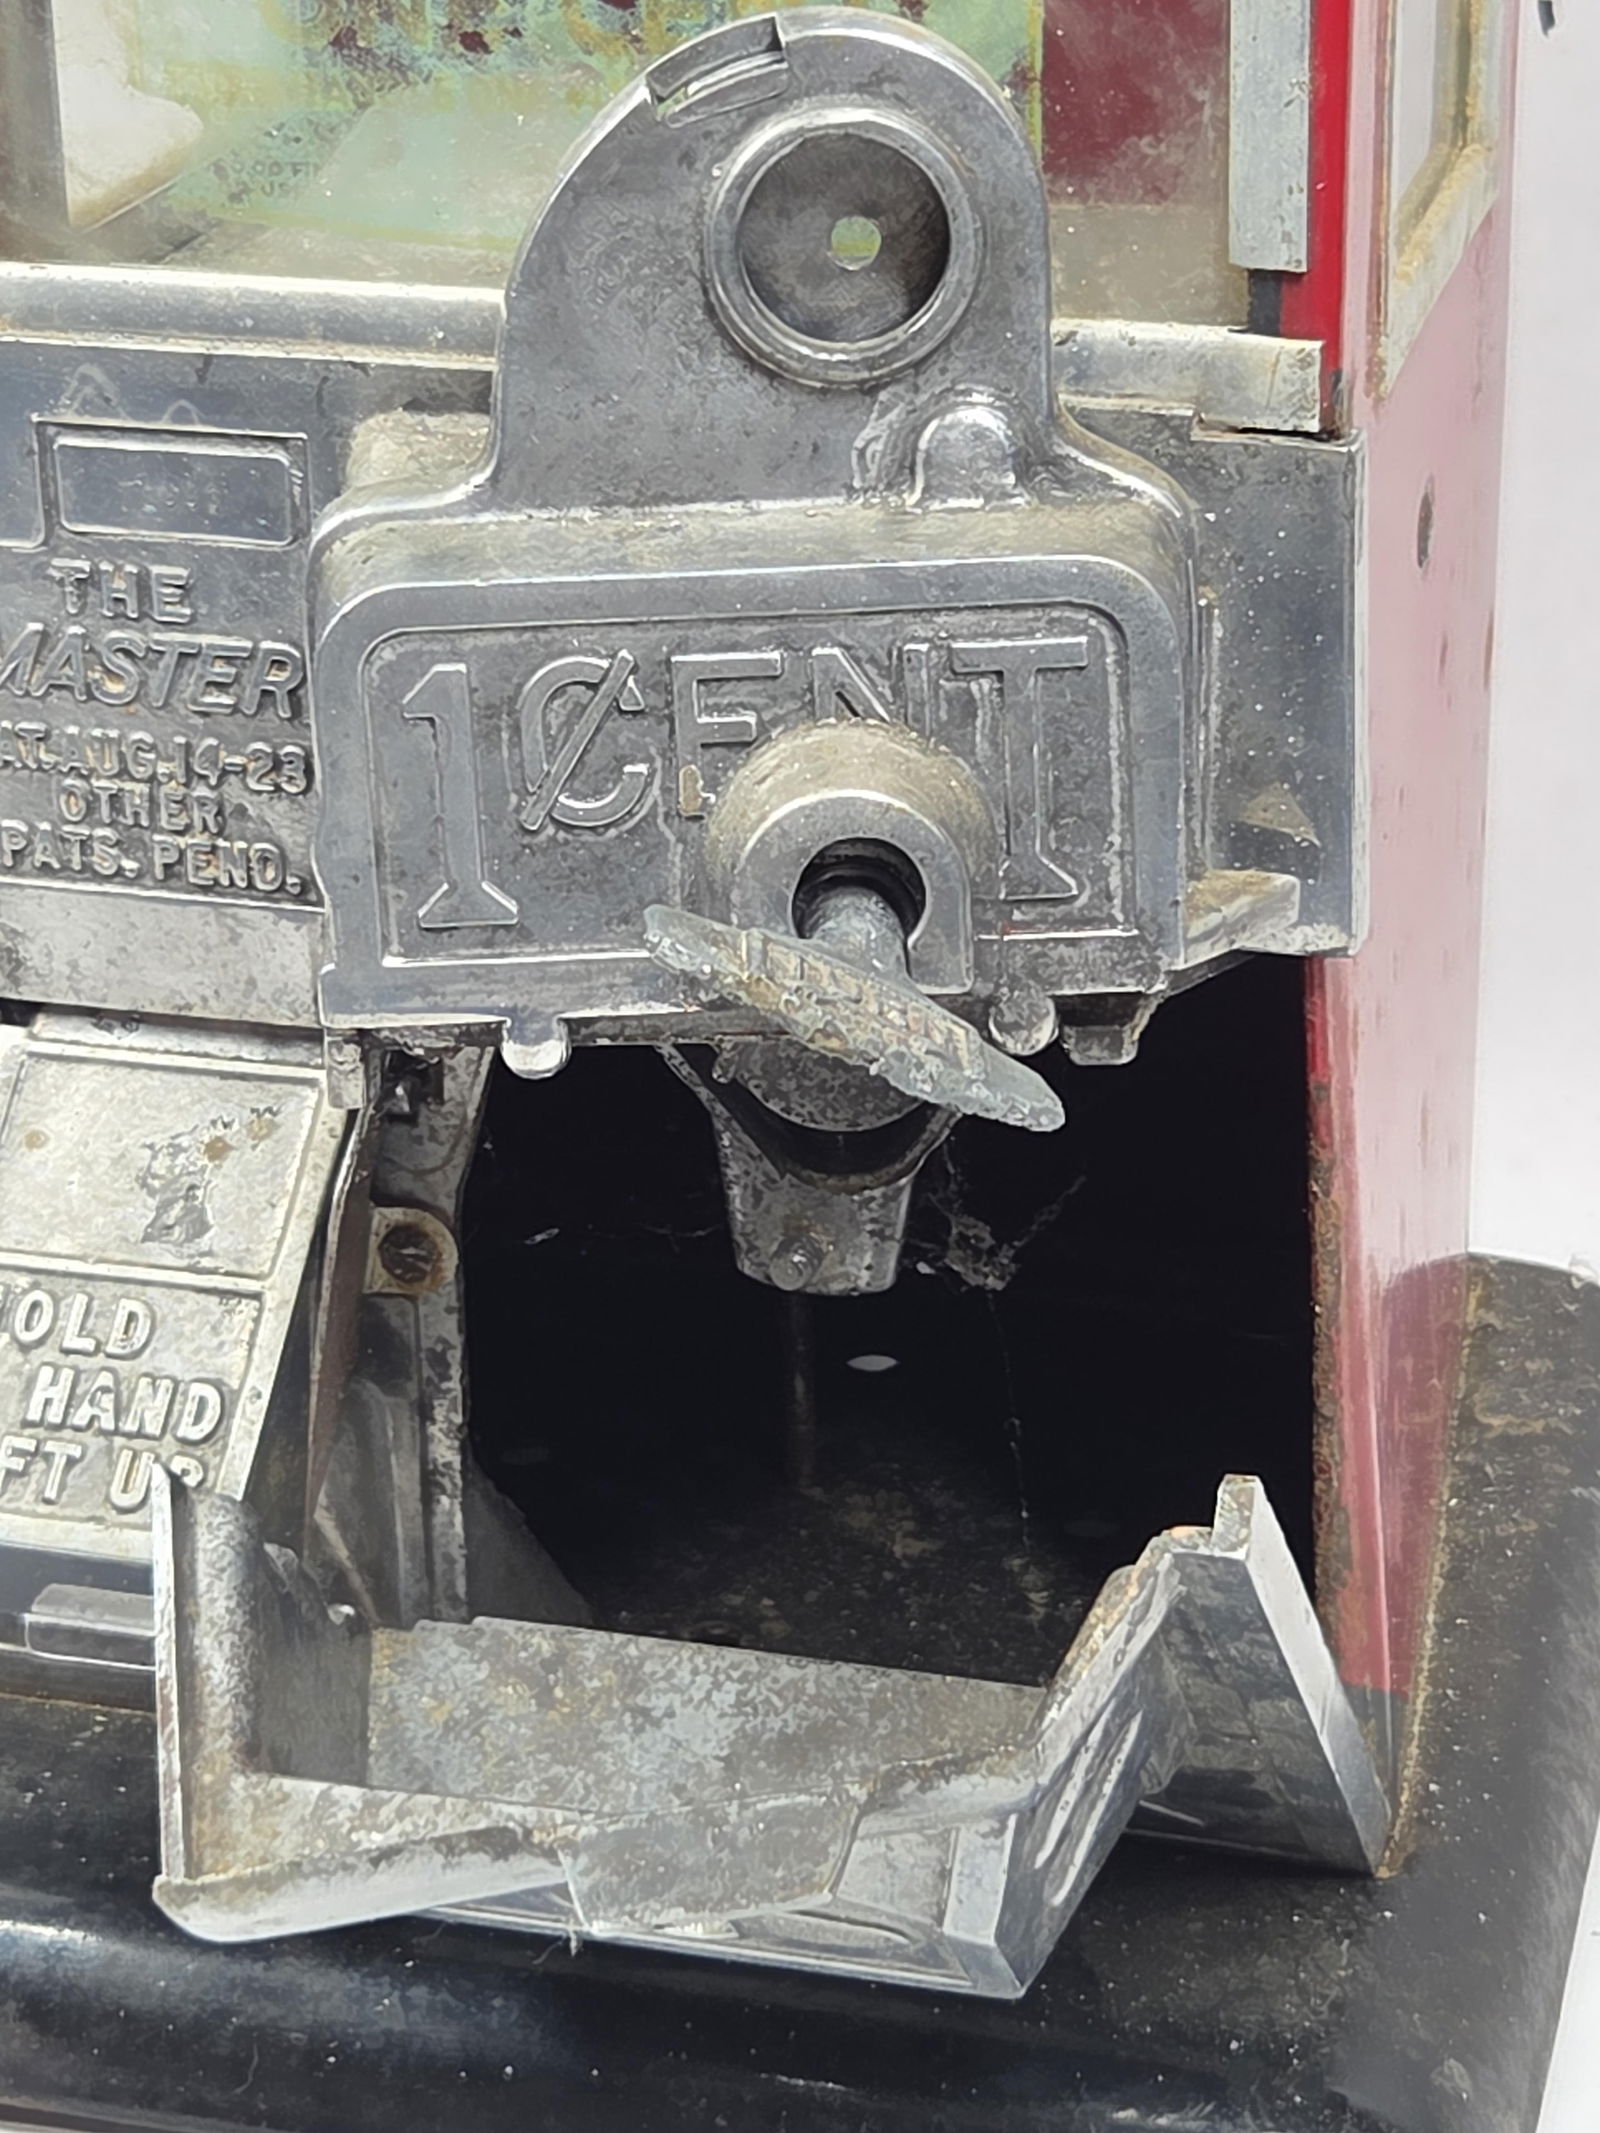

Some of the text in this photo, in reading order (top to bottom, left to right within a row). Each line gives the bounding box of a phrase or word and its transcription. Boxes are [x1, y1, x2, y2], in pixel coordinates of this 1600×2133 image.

[47, 556, 195, 625] THE
[58, 778, 222, 834] OTHER
[0, 818, 141, 881] PATS.
[0, 1282, 155, 1359] OLD
[22, 1362, 226, 1444] HAND
